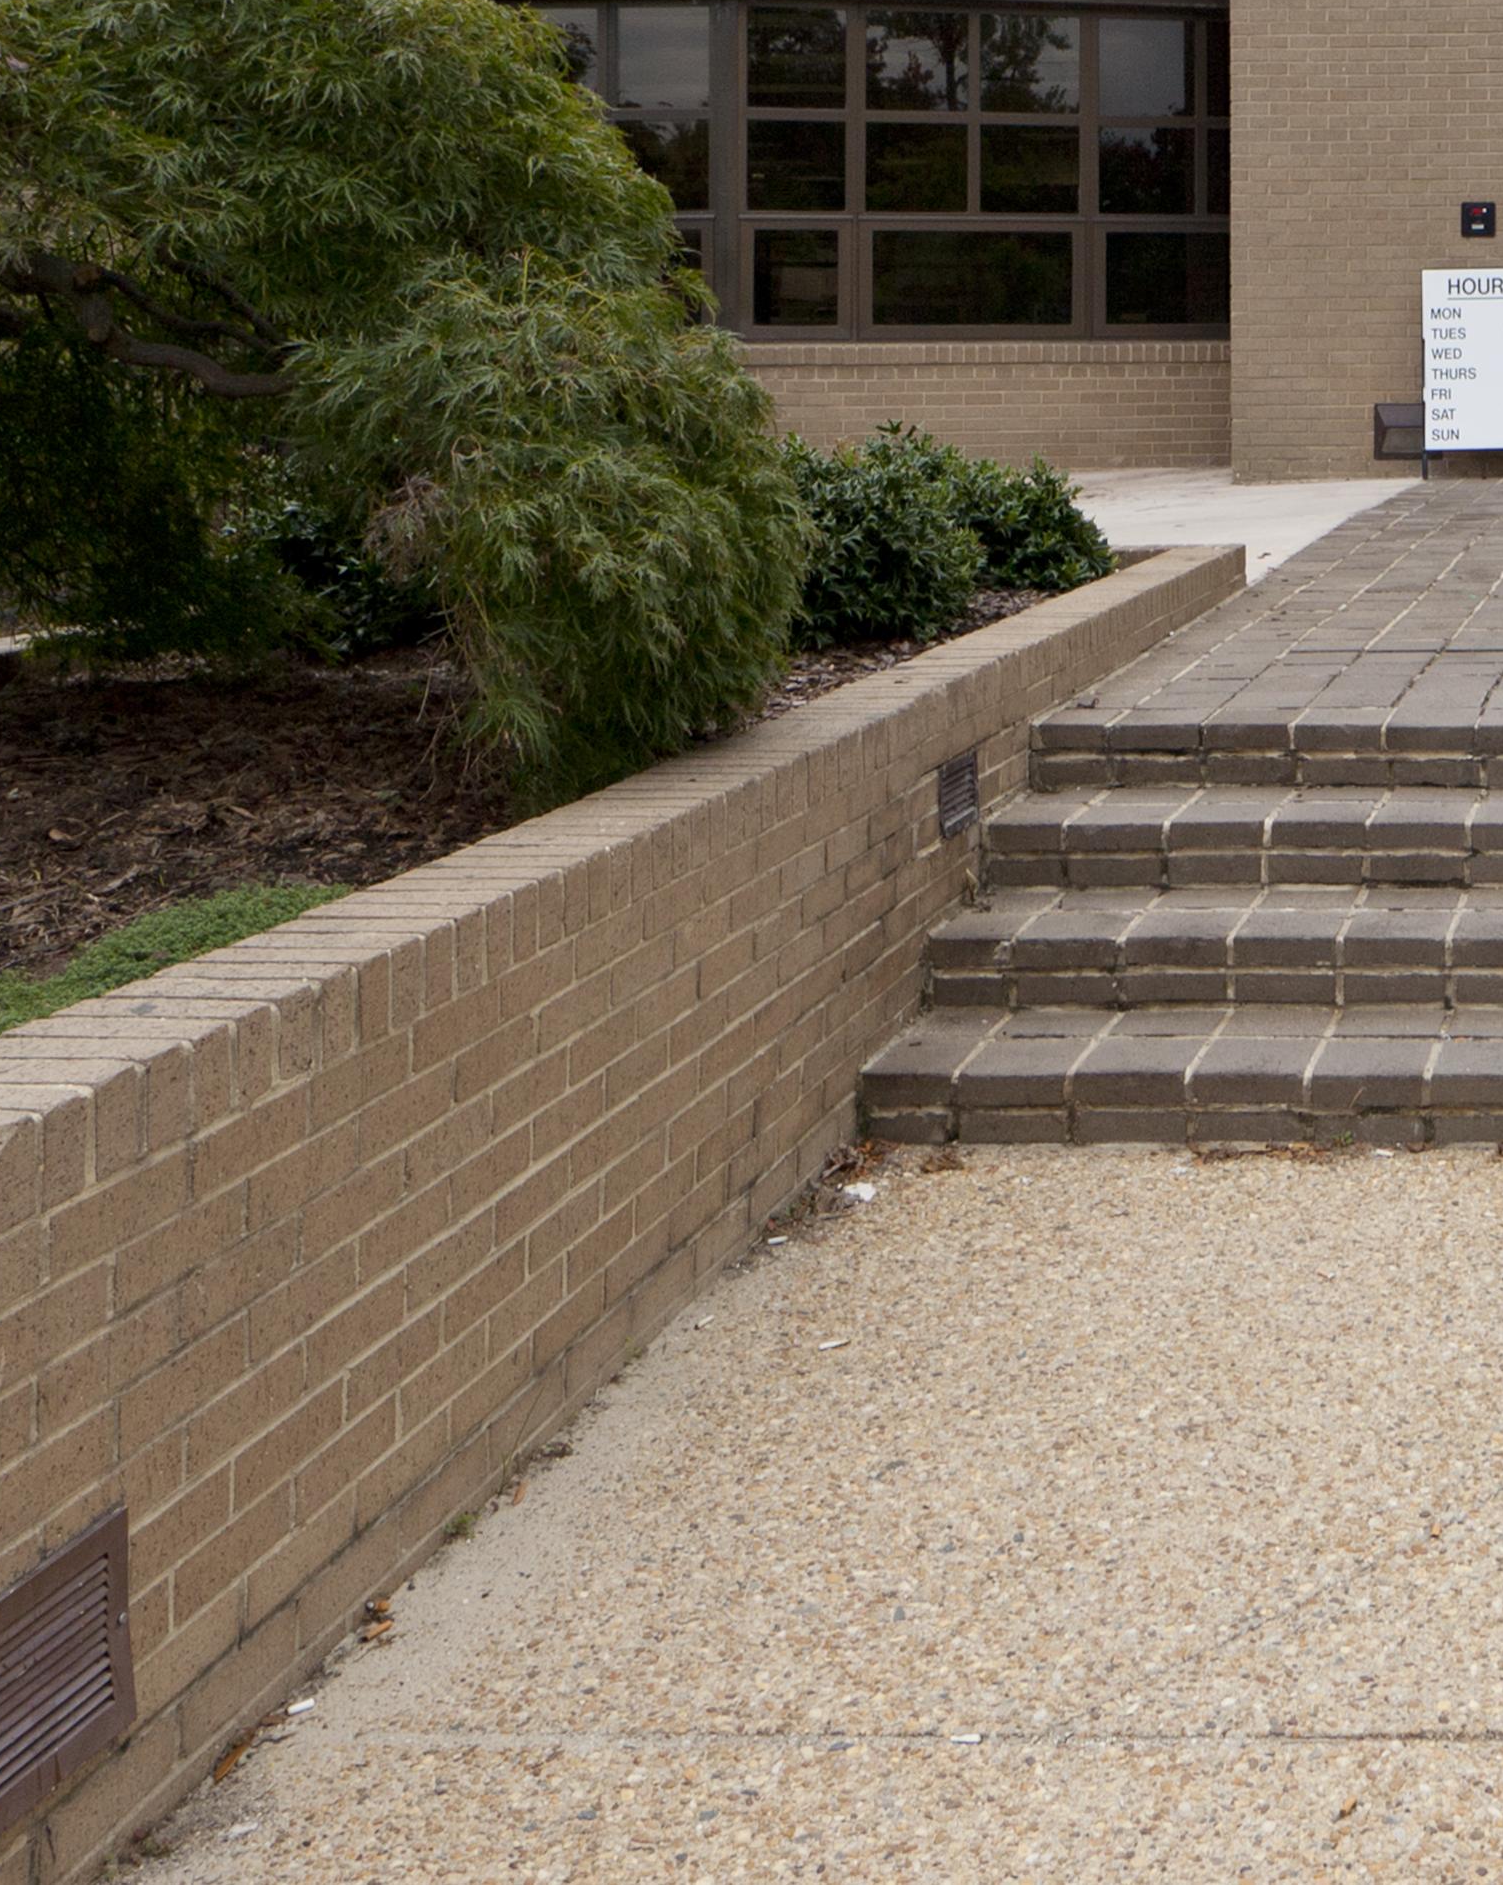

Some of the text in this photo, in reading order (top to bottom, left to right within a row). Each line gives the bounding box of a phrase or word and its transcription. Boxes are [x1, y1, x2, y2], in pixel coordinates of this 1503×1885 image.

[1431, 308, 1461, 319] MON
[1431, 328, 1466, 340] TUES
[1432, 348, 1462, 359] WED
[1432, 367, 1476, 380] THURS
[1431, 389, 1451, 400] FRI
[1432, 408, 1455, 420] SAT
[1432, 429, 1459, 441] SUN
